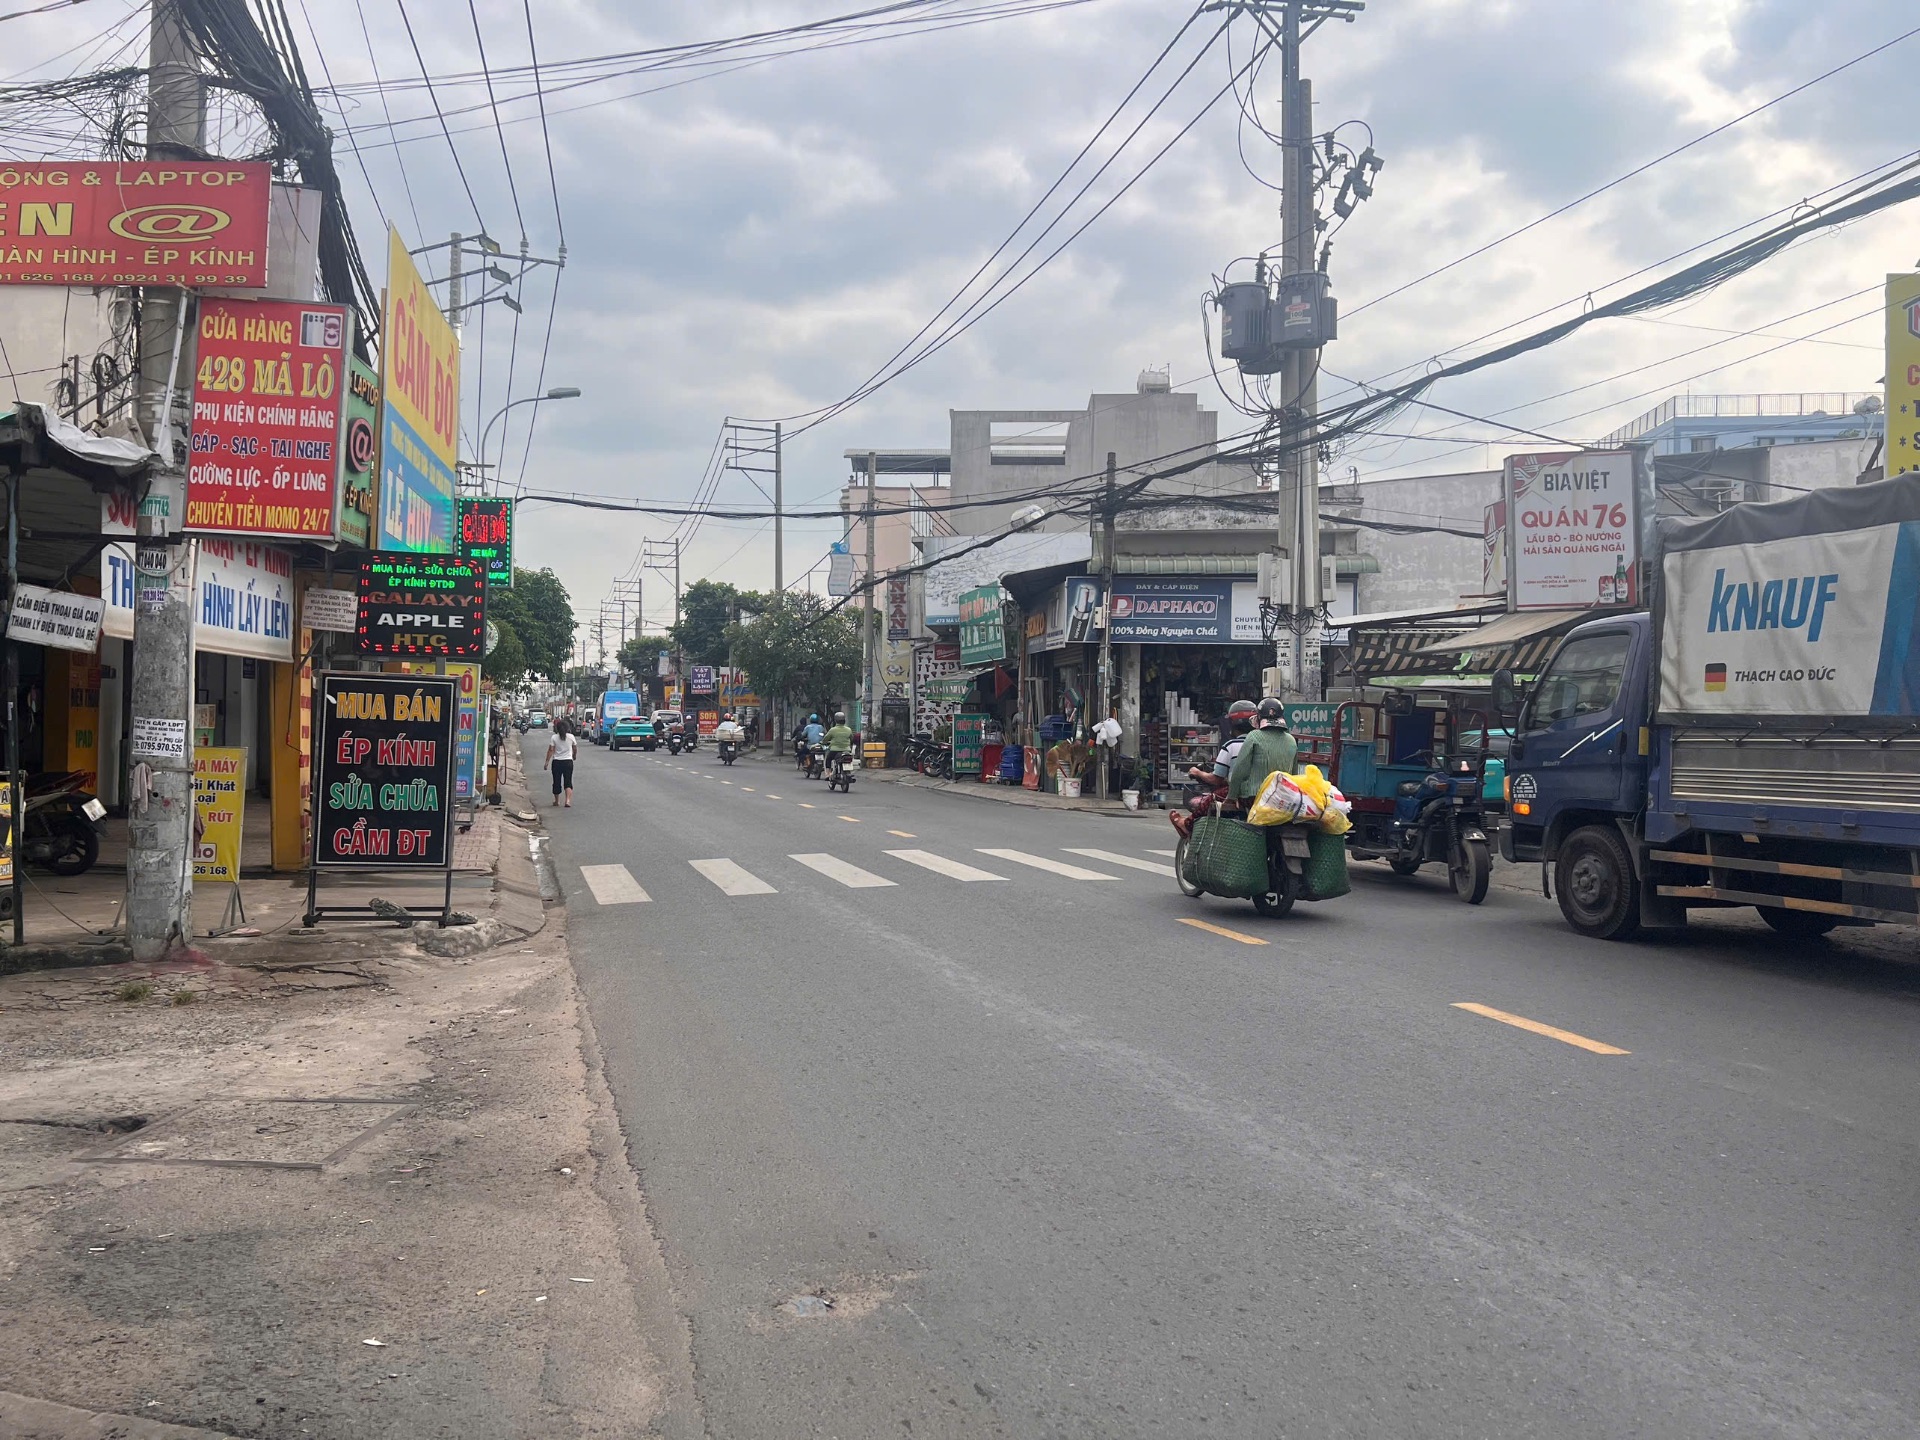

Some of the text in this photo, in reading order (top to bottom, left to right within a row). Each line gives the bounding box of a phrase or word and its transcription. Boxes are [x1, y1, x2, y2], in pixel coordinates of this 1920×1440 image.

[81, 171, 101, 186] &
[115, 171, 246, 186] LAPTOP
[108, 203, 232, 243] @
[53, 246, 116, 264] HÌNH
[144, 246, 179, 265] ÉP
[190, 247, 254, 265] KÍNH
[20, 273, 54, 282] 626
[62, 273, 94, 282] 168
[113, 274, 158, 283] 0924
[166, 275, 185, 284] 31
[195, 275, 217, 284] 99
[225, 275, 247, 284] 39
[202, 307, 292, 345] CỬA HÀNG
[394, 282, 430, 422] CẦM
[434, 342, 455, 448] ĐỒ
[197, 351, 335, 399] 428 MÃ LÒ
[193, 400, 334, 429] PHỤ KIỆN CHÍNH HÃNG
[191, 429, 331, 460] CÁP SẠC TAI NGHE
[189, 462, 326, 492] CƯỜNG LỰC ỐP LƯNG
[187, 491, 233, 525] CHUYỂN
[236, 494, 262, 527] TIỀN
[265, 505, 299, 530] MOMO
[302, 507, 330, 532] 24/7
[385, 464, 404, 542] LÊ
[1521, 502, 1627, 529] QUÁN 76
[1527, 530, 1621, 543] LẨU BÒ BÒ NƯỚNG
[1523, 542, 1625, 555] HẢI SẢN QUẢNG NGÃI
[373, 563, 473, 577] MUA BÁN SỬA CHỮA
[389, 576, 401, 586] ÉP
[404, 576, 427, 588] KÍNH
[203, 572, 234, 630] HÌNH
[239, 578, 261, 634] LẤY
[264, 584, 289, 640] LIỀN
[369, 591, 475, 607] GALAXY
[1135, 600, 1216, 614] DAPHACO
[1706, 568, 1839, 643] KNAUF
[33, 599, 50, 616] ĐIỆN
[51, 603, 70, 620] THOẠI
[72, 606, 84, 620] GIÁ
[85, 610, 98, 623] CAO
[377, 613, 465, 628] APPLE
[11, 615, 31, 629] THANH
[32, 617, 41, 631] LÝ
[41, 620, 55, 635] ĐIỆN
[56, 624, 74, 639] THOẠI
[75, 626, 86, 639] GIÁ
[1110, 625, 1218, 637] 100% Đồng Nguyên Chất
[393, 633, 448, 647] HTC
[1734, 666, 1836, 685] THẠCH CAO ĐỨC
[336, 689, 441, 722] MUA BÁN
[1291, 706, 1328, 724] QUÁN
[700, 712, 717, 720] SOFA
[76, 730, 92, 748] IPAD
[337, 731, 436, 766] ÉP KÍNH
[211, 757, 238, 773] MÁY
[207, 780, 235, 791] Khát
[329, 773, 438, 811] SỬA CHỮA
[195, 793, 216, 805] oại
[208, 810, 234, 822] RÚT
[333, 817, 431, 856] CẦM ĐT
[193, 866, 227, 875] 26 168
